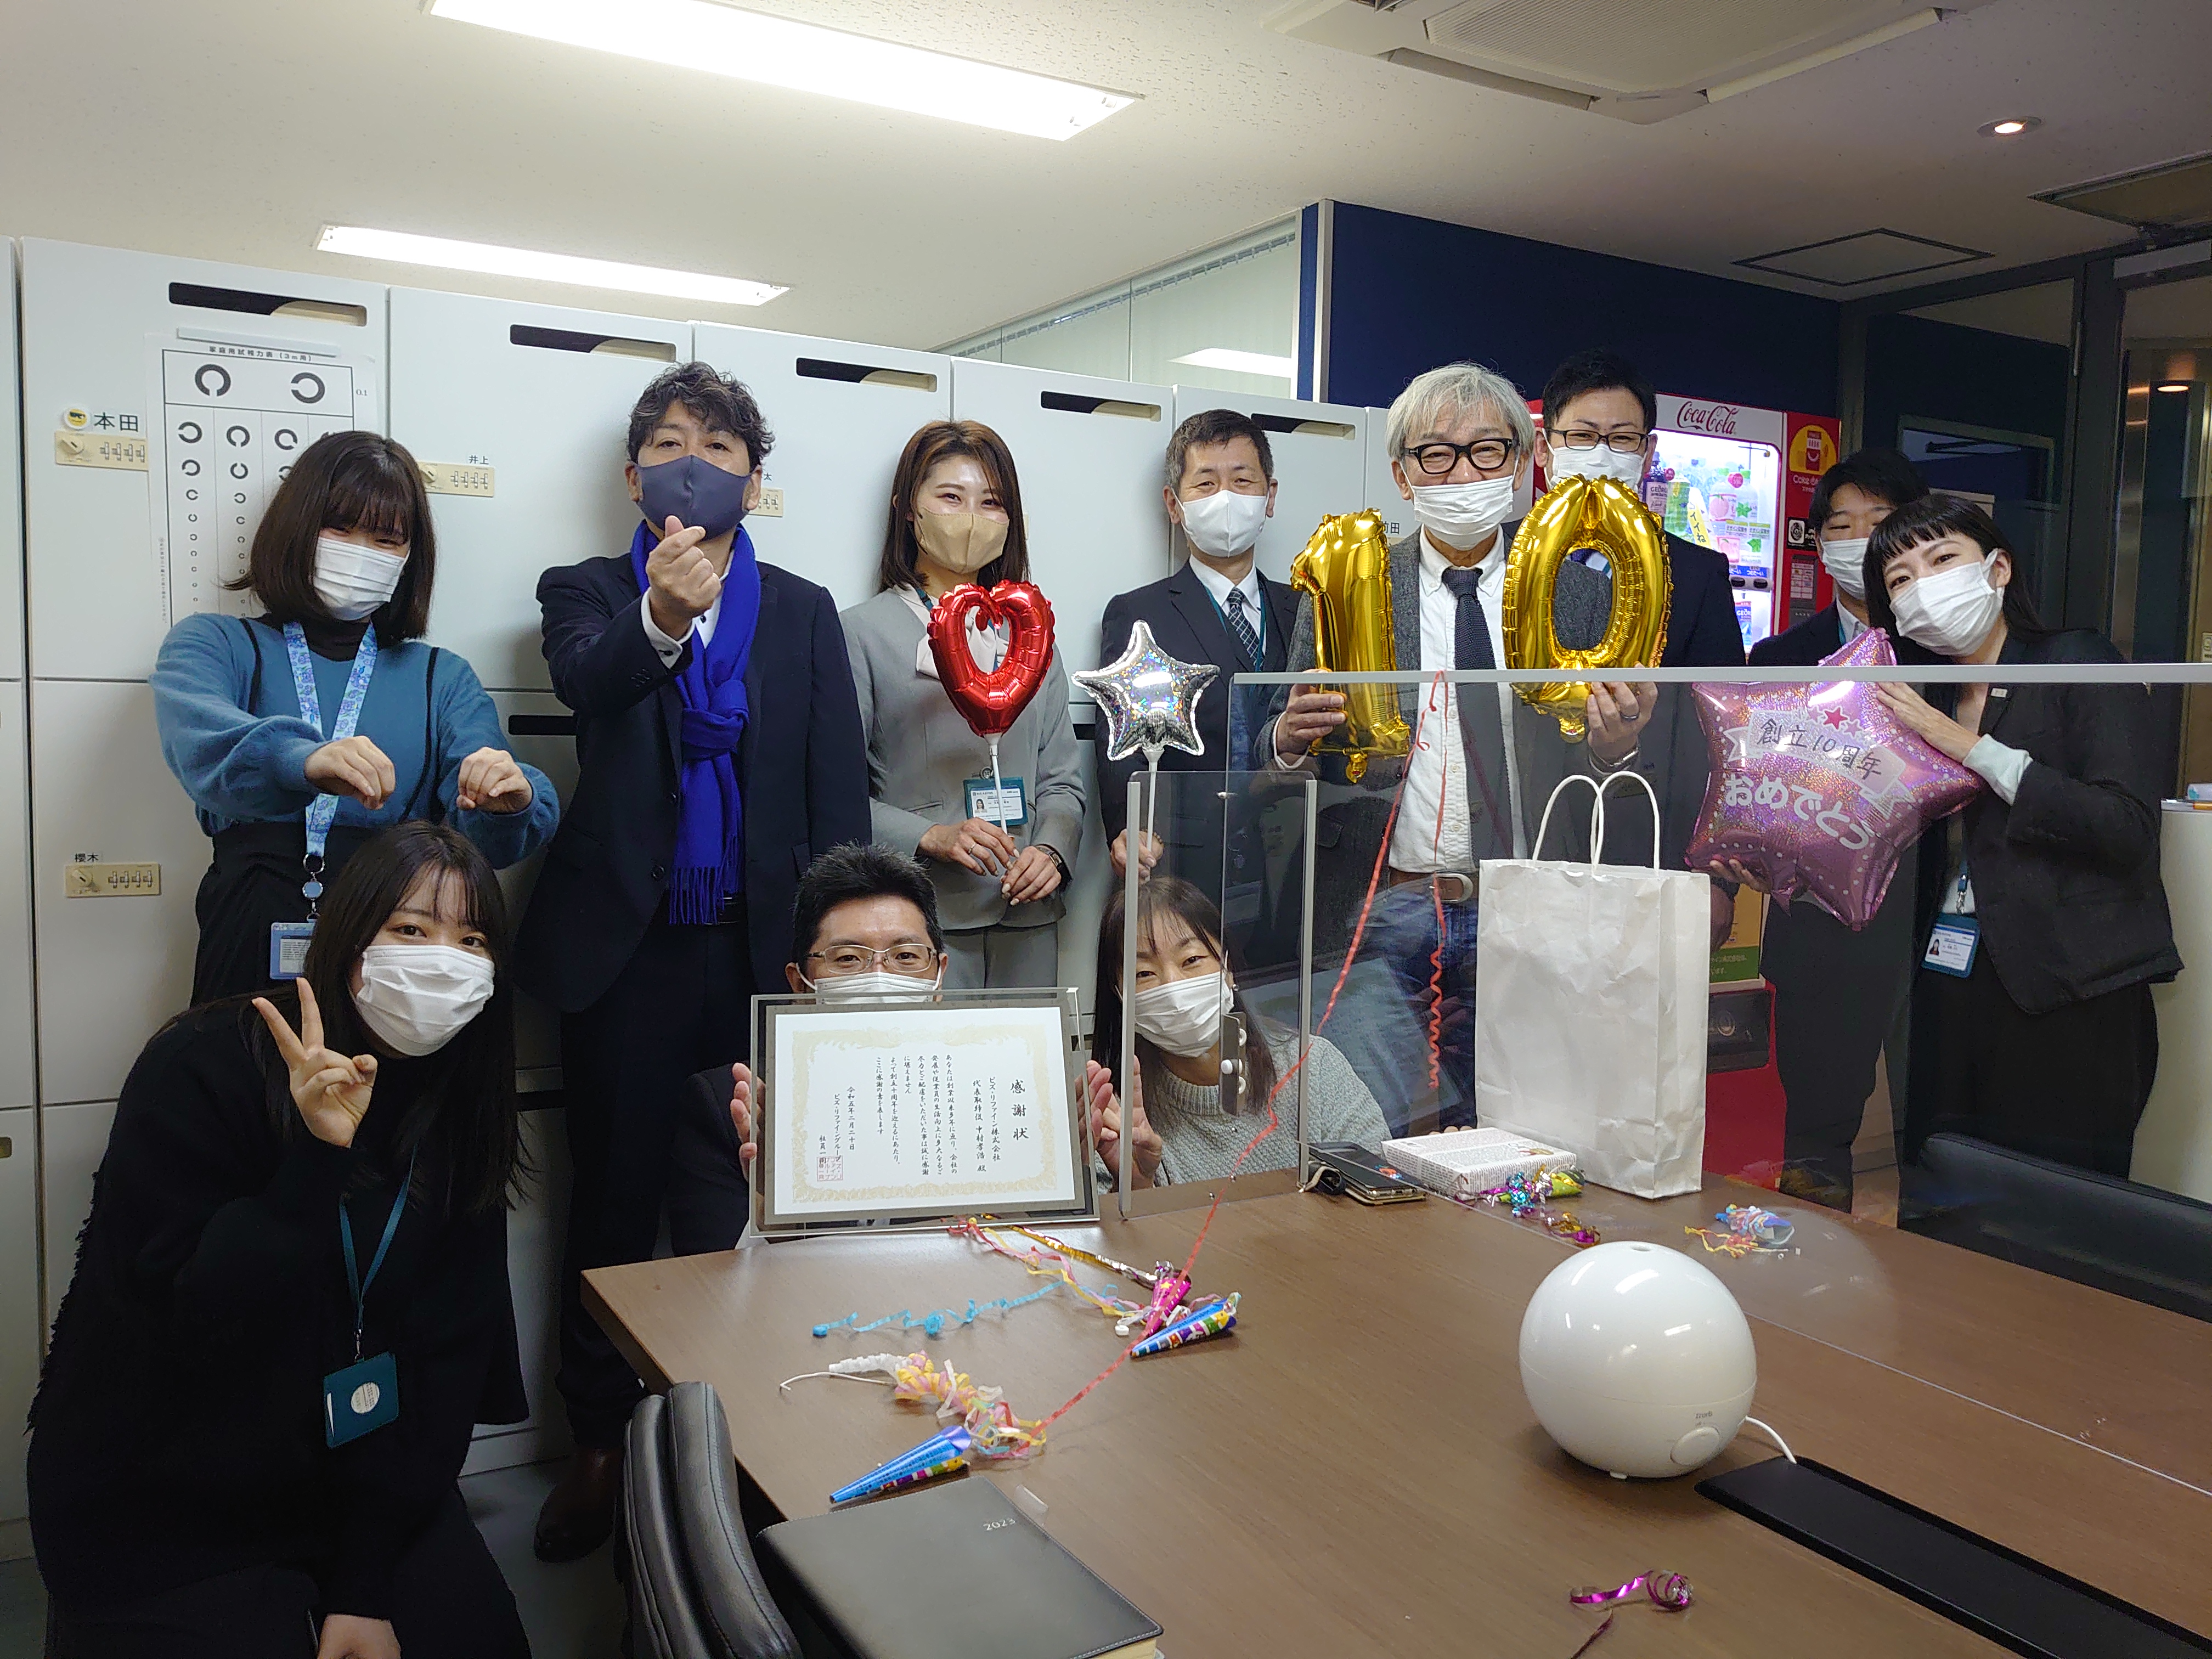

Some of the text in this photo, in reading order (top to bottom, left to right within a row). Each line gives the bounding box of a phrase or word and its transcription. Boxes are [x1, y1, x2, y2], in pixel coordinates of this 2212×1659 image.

[94, 412, 138, 432] 本田
[1677, 401, 1739, 435] Coca-Cola
[469, 455, 489, 465] 井上
[1757, 718, 1882, 780] 創立10周年
[1724, 773, 1869, 850] おめでとう
[847, 1086, 855, 1150] 令和五年二月二十日
[973, 1080, 984, 1120] 代表取締役
[1010, 1080, 1029, 1141] 感謝状
[983, 1517, 1015, 1531] 2023
